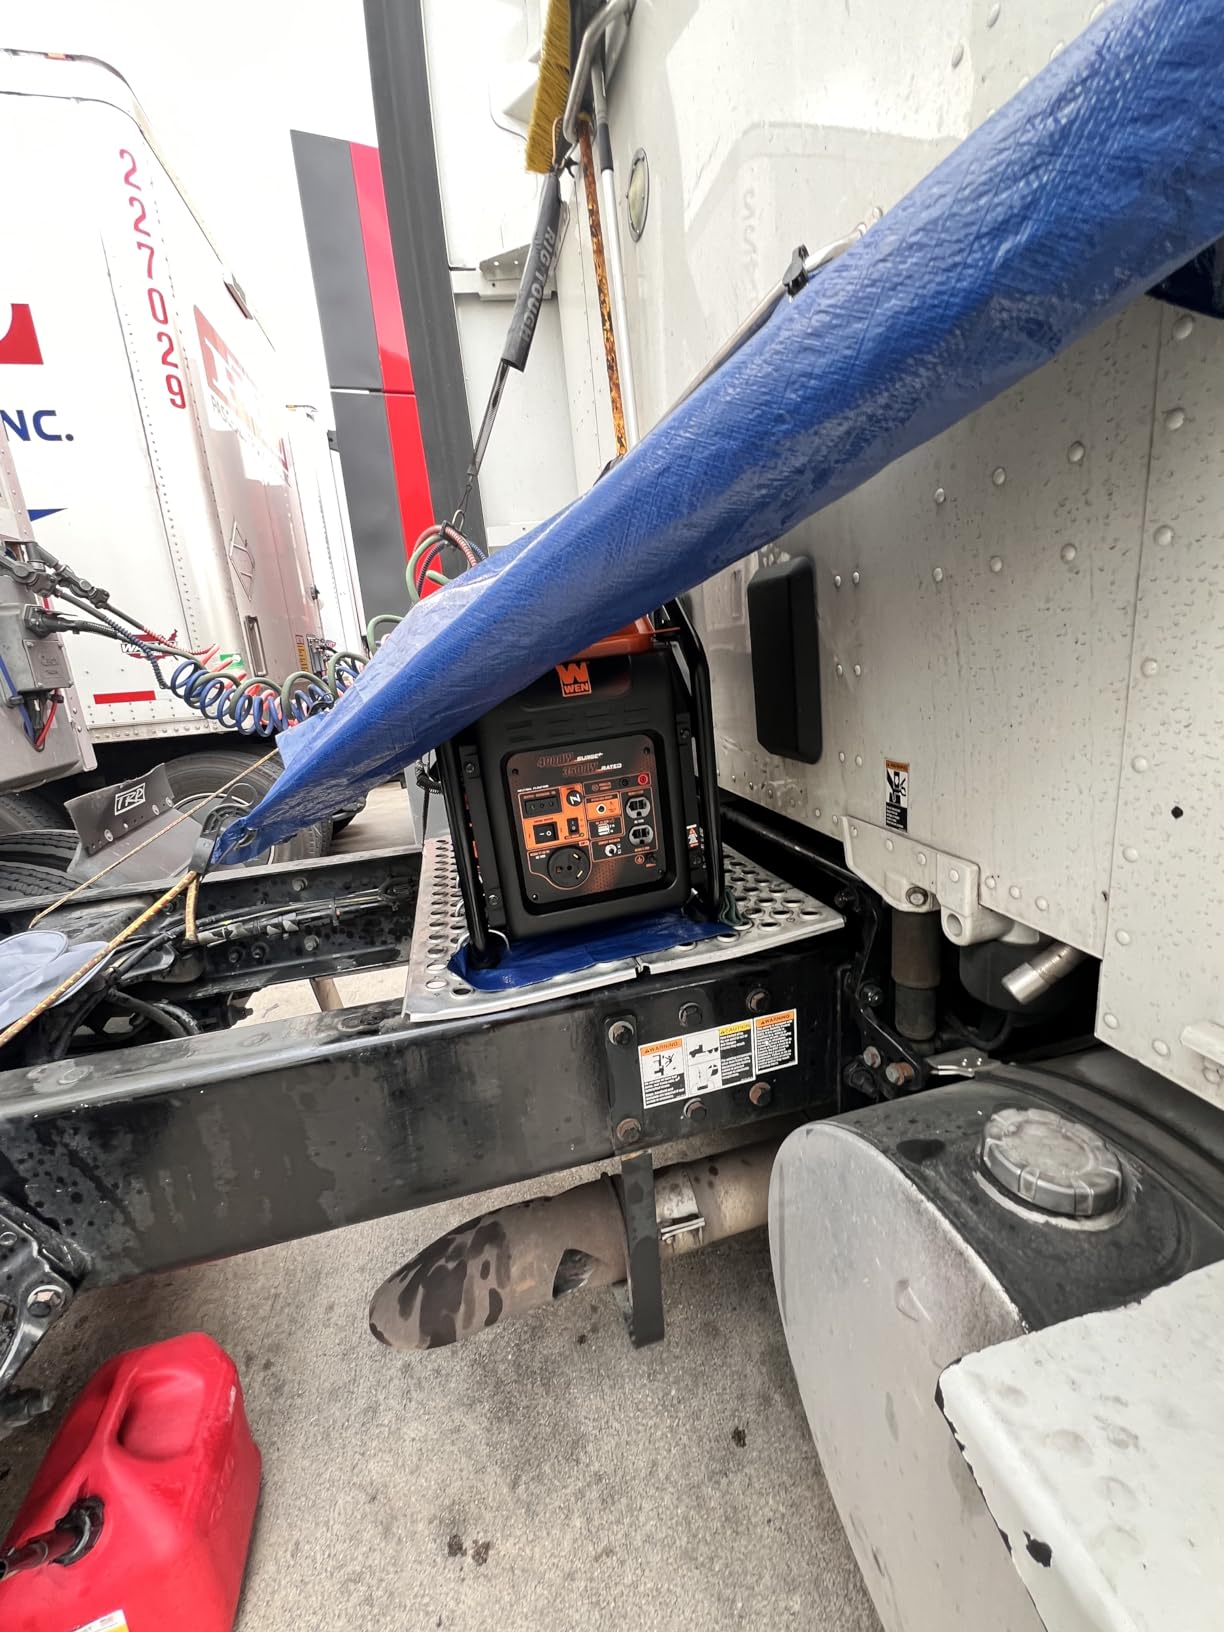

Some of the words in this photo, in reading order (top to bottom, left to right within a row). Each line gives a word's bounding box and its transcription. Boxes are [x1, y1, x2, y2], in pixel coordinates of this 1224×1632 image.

[119, 148, 186, 409] 227029
[564, 682, 589, 694] WEN
[117, 787, 143, 810] TRP
[765, 1014, 790, 1025] WARNING
